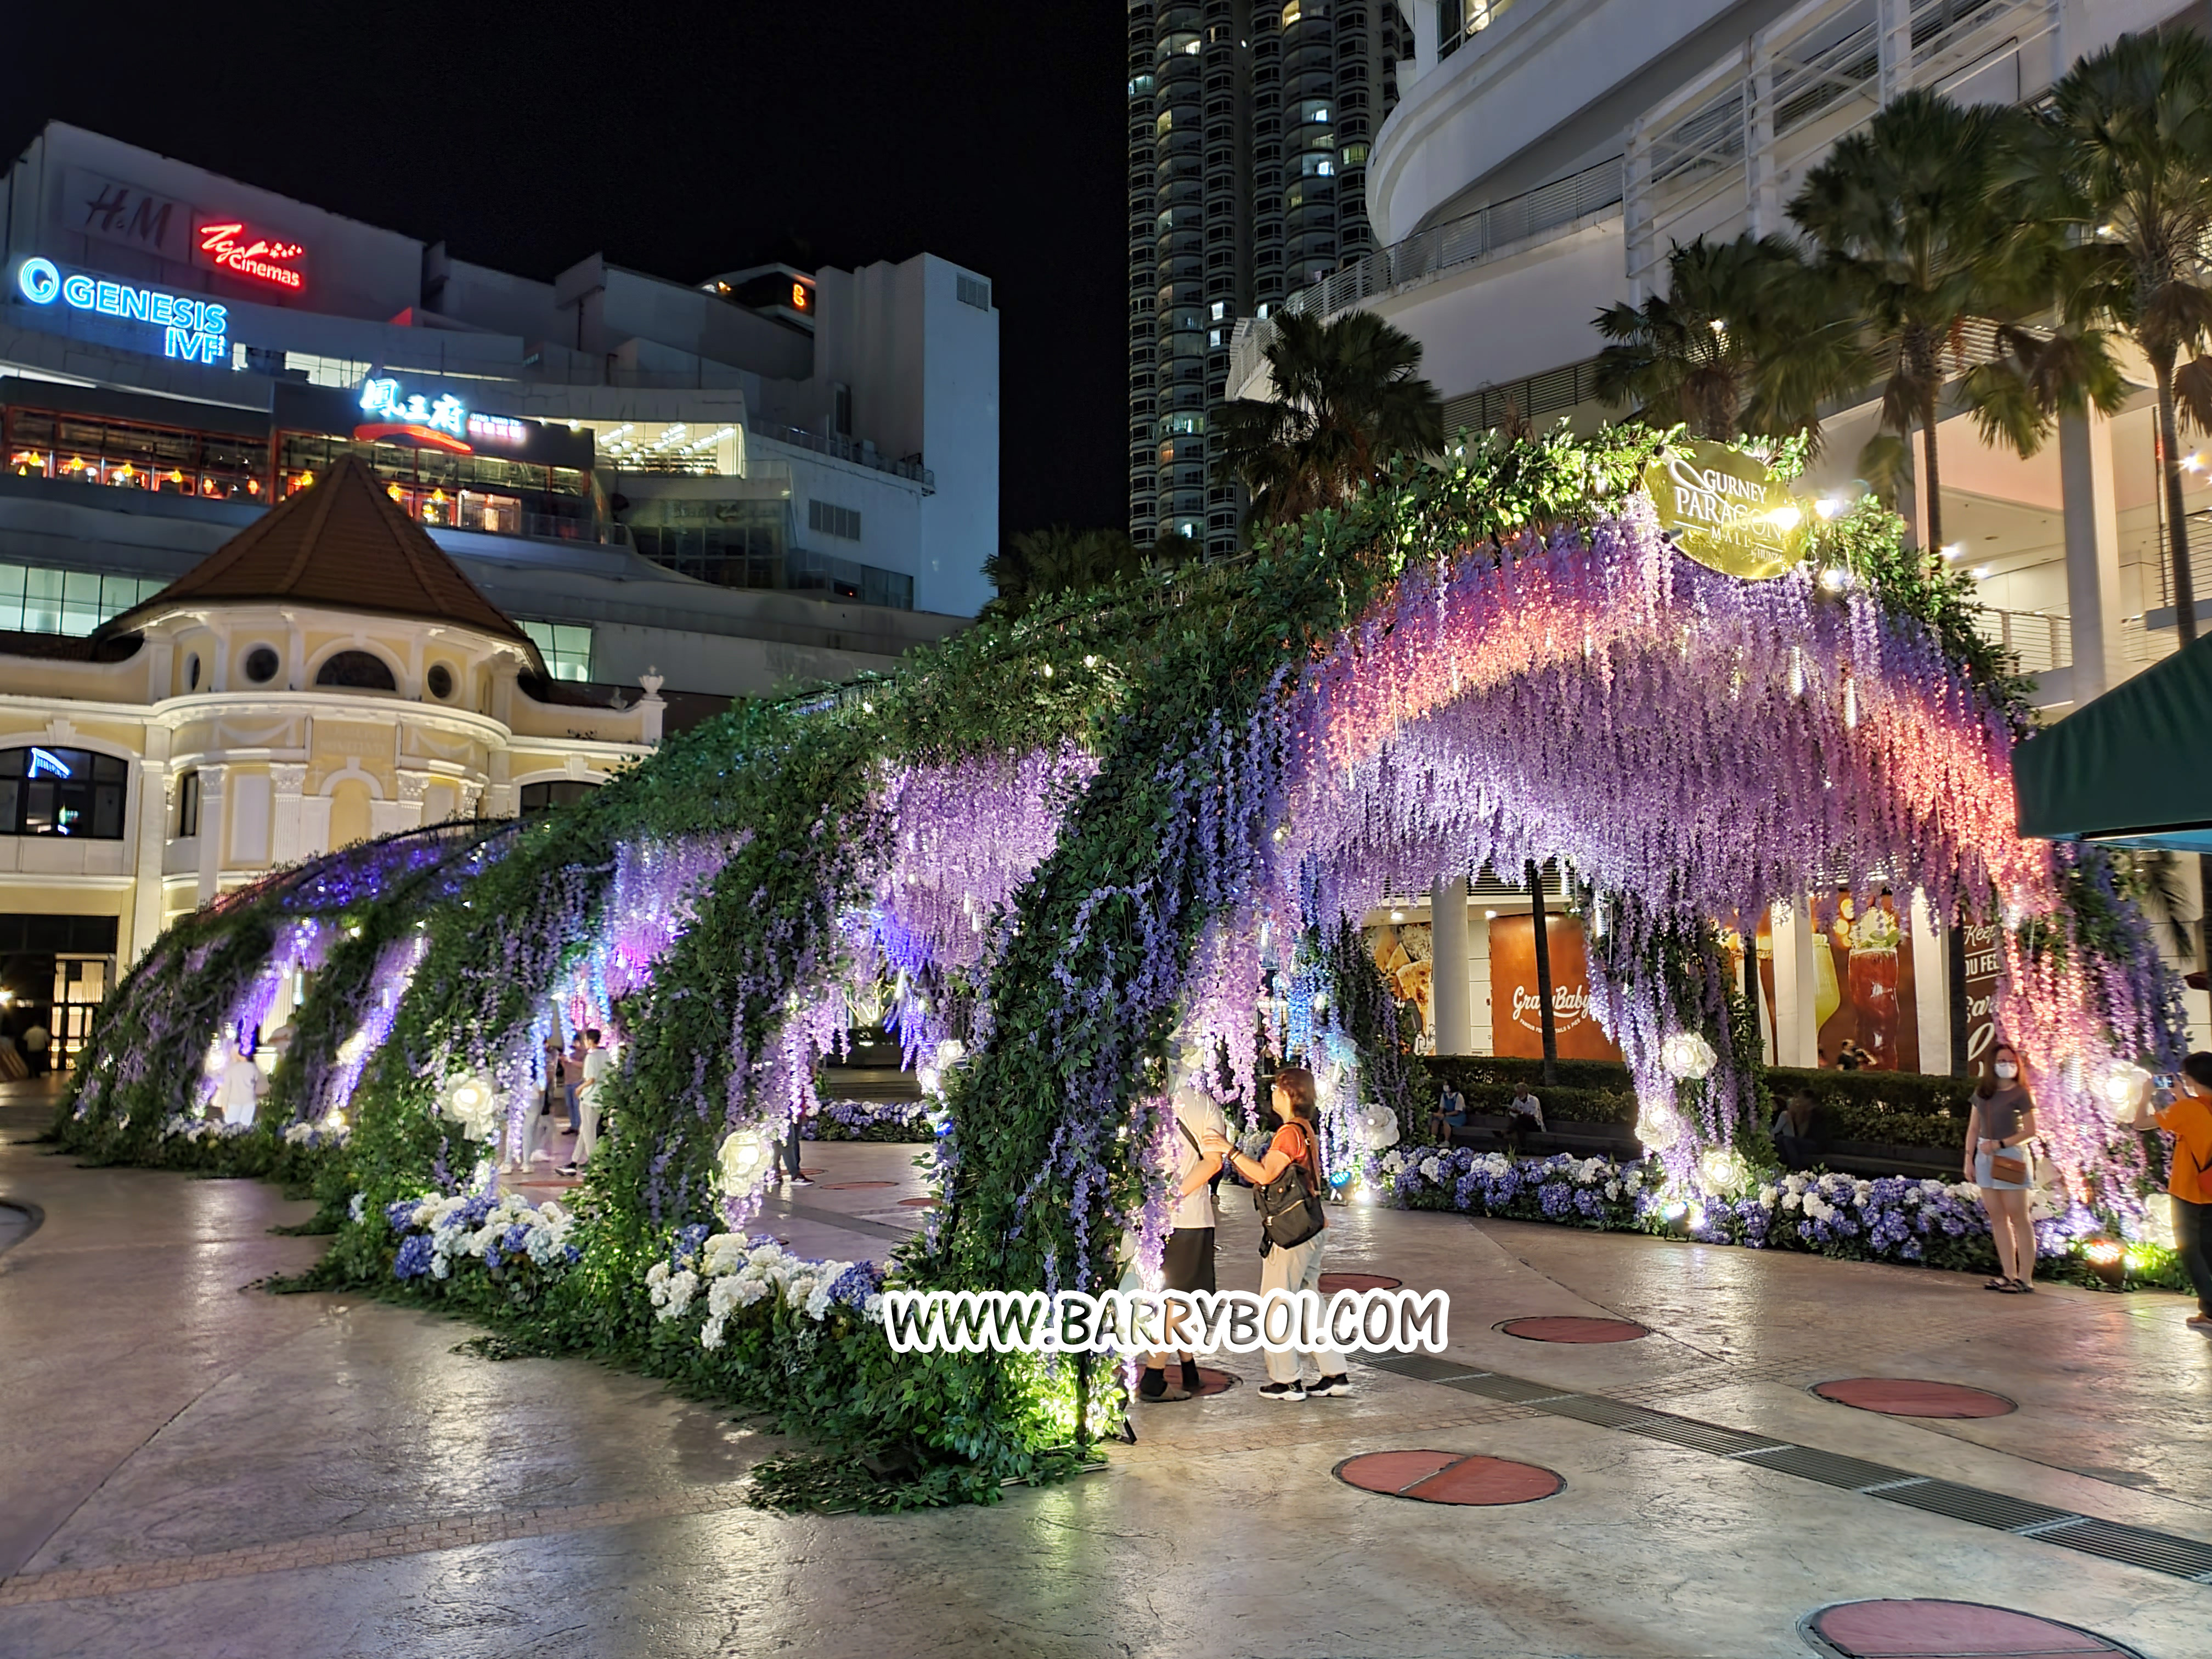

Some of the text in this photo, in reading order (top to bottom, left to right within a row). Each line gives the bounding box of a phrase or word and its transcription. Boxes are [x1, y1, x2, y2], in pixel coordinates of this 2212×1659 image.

[86, 183, 174, 250] H&M
[229, 254, 300, 289] Cinemas
[64, 275, 228, 335] GENESIS
[165, 326, 218, 364] IVF
[1701, 468, 1768, 504] GURNEY
[1674, 486, 1782, 541] PARAGON
[1711, 525, 1752, 548] MALL
